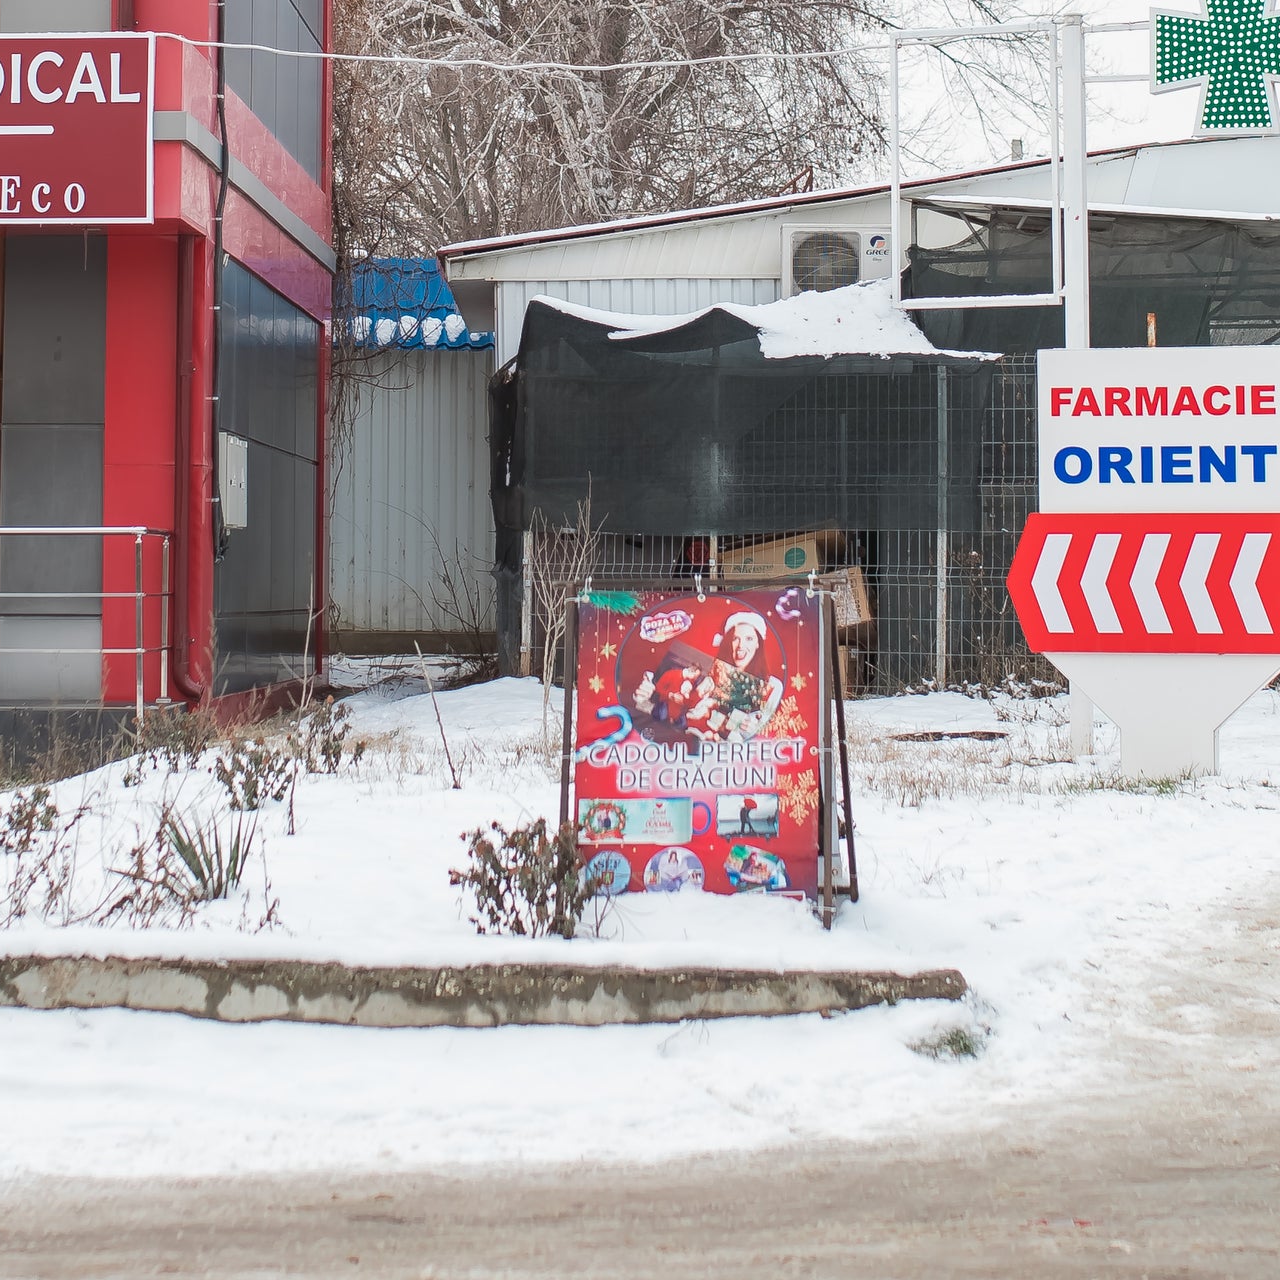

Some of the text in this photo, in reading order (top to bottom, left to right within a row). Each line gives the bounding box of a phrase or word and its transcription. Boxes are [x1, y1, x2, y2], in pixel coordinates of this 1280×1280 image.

[1050, 385, 1277, 417] FARMACIE
[1053, 445, 1278, 484] ORIENT
[589, 739, 806, 766] CADOUL PERFECT
[619, 766, 651, 790] DE
